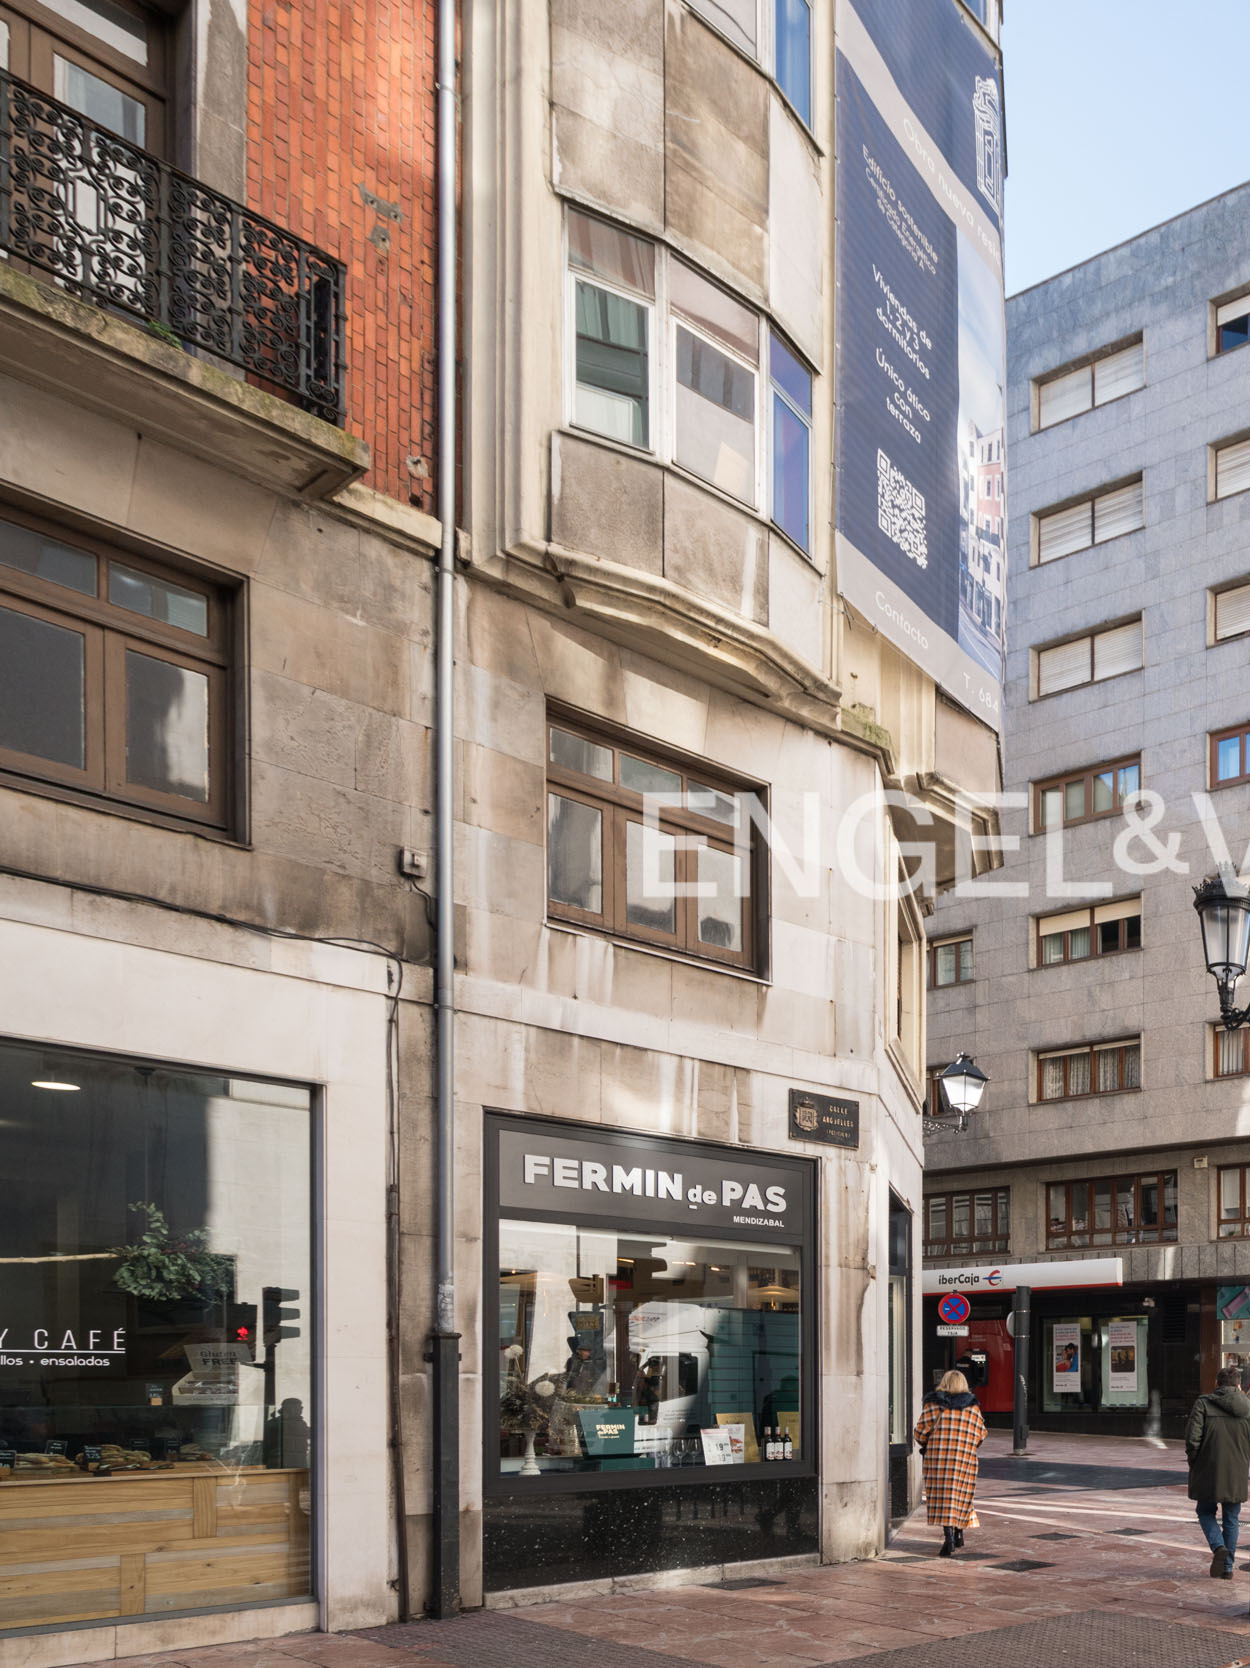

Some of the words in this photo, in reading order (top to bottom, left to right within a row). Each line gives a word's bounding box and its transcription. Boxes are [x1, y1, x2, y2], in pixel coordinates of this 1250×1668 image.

[904, 117, 935, 174] Obra
[938, 173, 974, 228] nueva
[863, 143, 896, 201] Edificio
[898, 200, 938, 263] sostenible
[873, 264, 918, 334] Viviendas
[920, 327, 932, 350] de
[896, 314, 902, 330] 2
[905, 327, 911, 342] y
[912, 335, 919, 350] 3
[876, 307, 930, 380] dormitorios
[876, 348, 905, 392] Único
[906, 387, 931, 422] ático
[894, 392, 912, 419] con
[886, 397, 921, 444] terraza
[875, 591, 929, 649] Contacto
[523, 1154, 683, 1201] FERMIN
[687, 1184, 717, 1210] de
[721, 1179, 787, 1213] PAS
[733, 1215, 785, 1228] MENDIZABAL
[938, 1273, 980, 1286] iberCaja
[34, 1328, 126, 1350] CAFÉ
[40, 1356, 111, 1367] ensaladas
